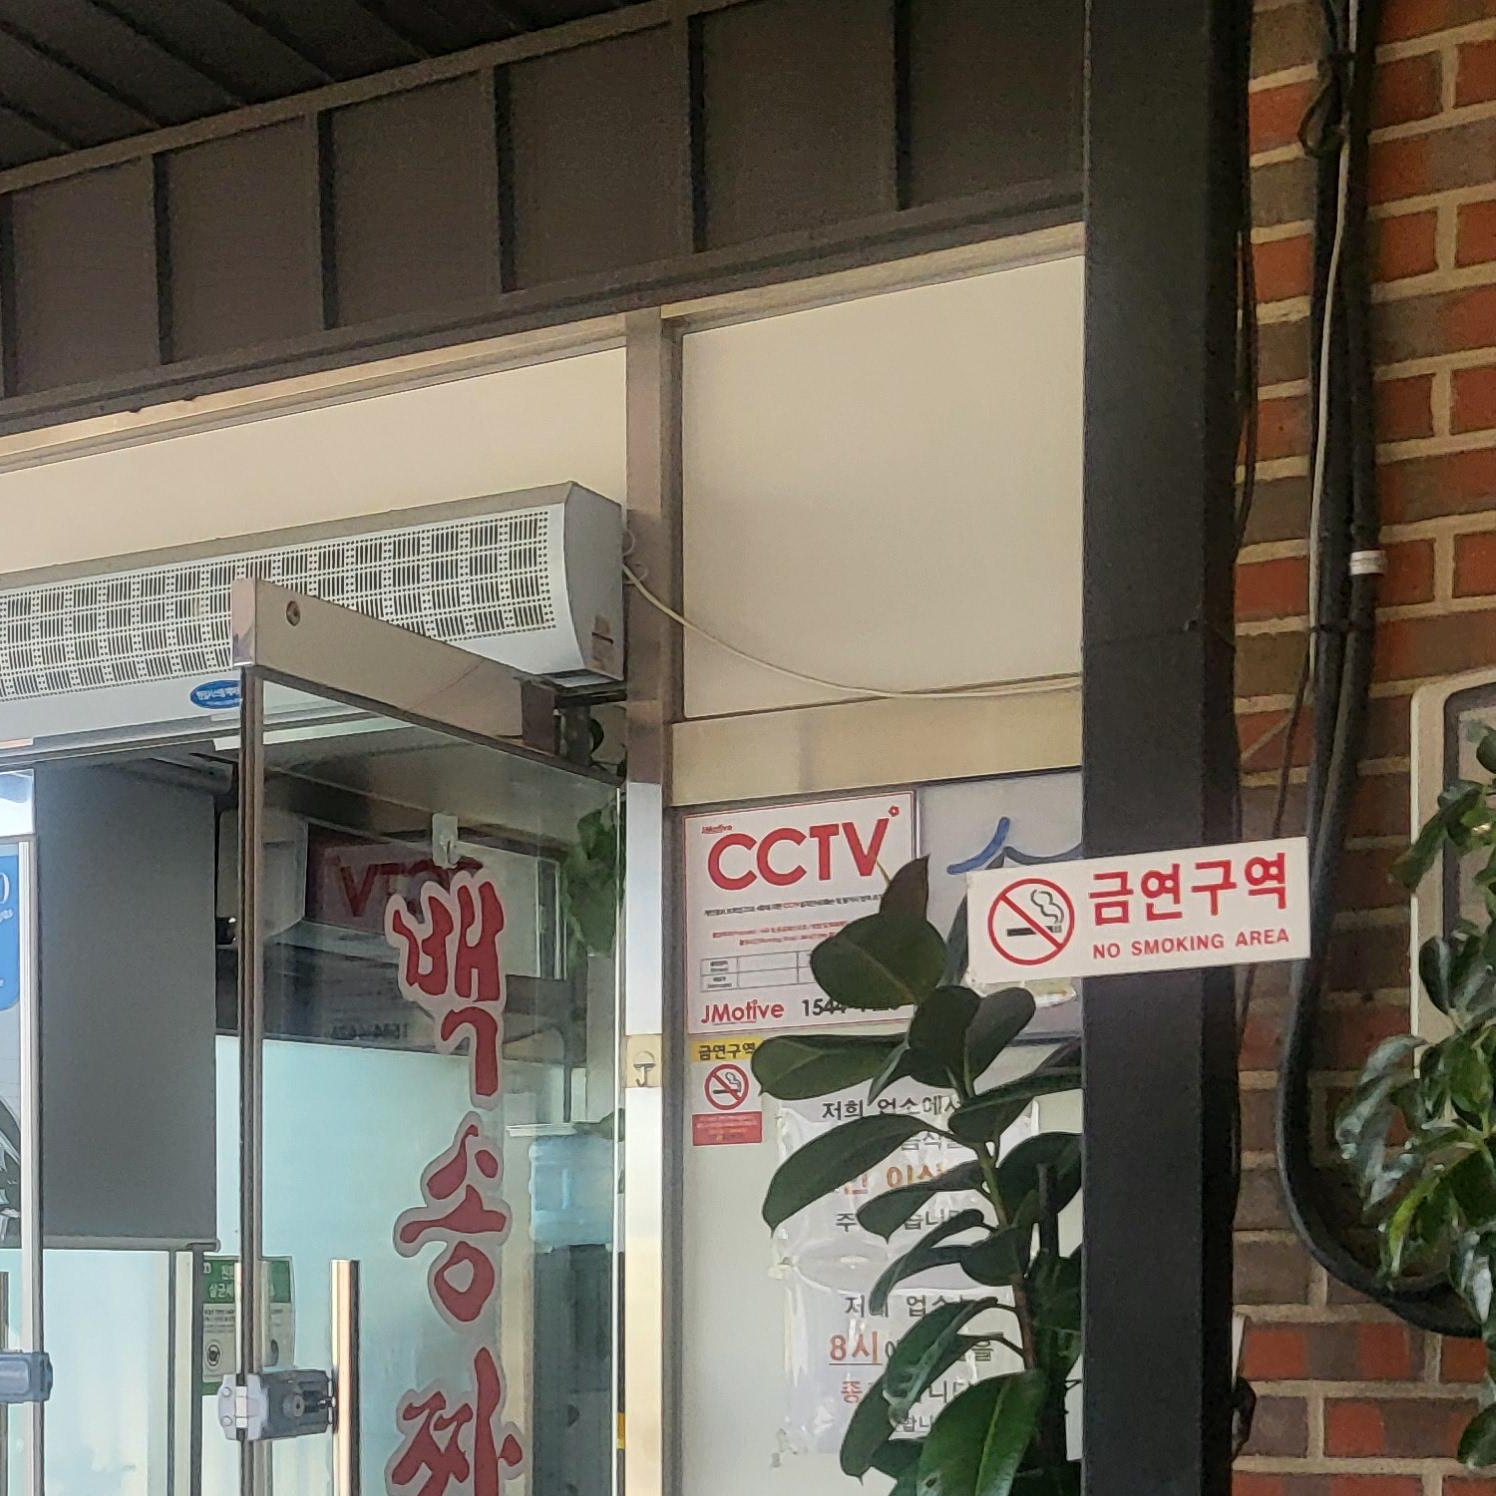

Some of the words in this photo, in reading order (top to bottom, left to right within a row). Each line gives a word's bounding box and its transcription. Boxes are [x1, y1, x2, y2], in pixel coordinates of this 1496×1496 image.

[708, 818, 890, 891] CCTV
[1088, 852, 1287, 926] 금연구역
[1092, 943, 1121, 960] NO
[1131, 933, 1225, 957] SMOKING
[1235, 927, 1290, 947] AREA
[700, 1000, 785, 1025] JMotive
[698, 1042, 756, 1061] 금연구역
[822, 1100, 864, 1121] 저희
